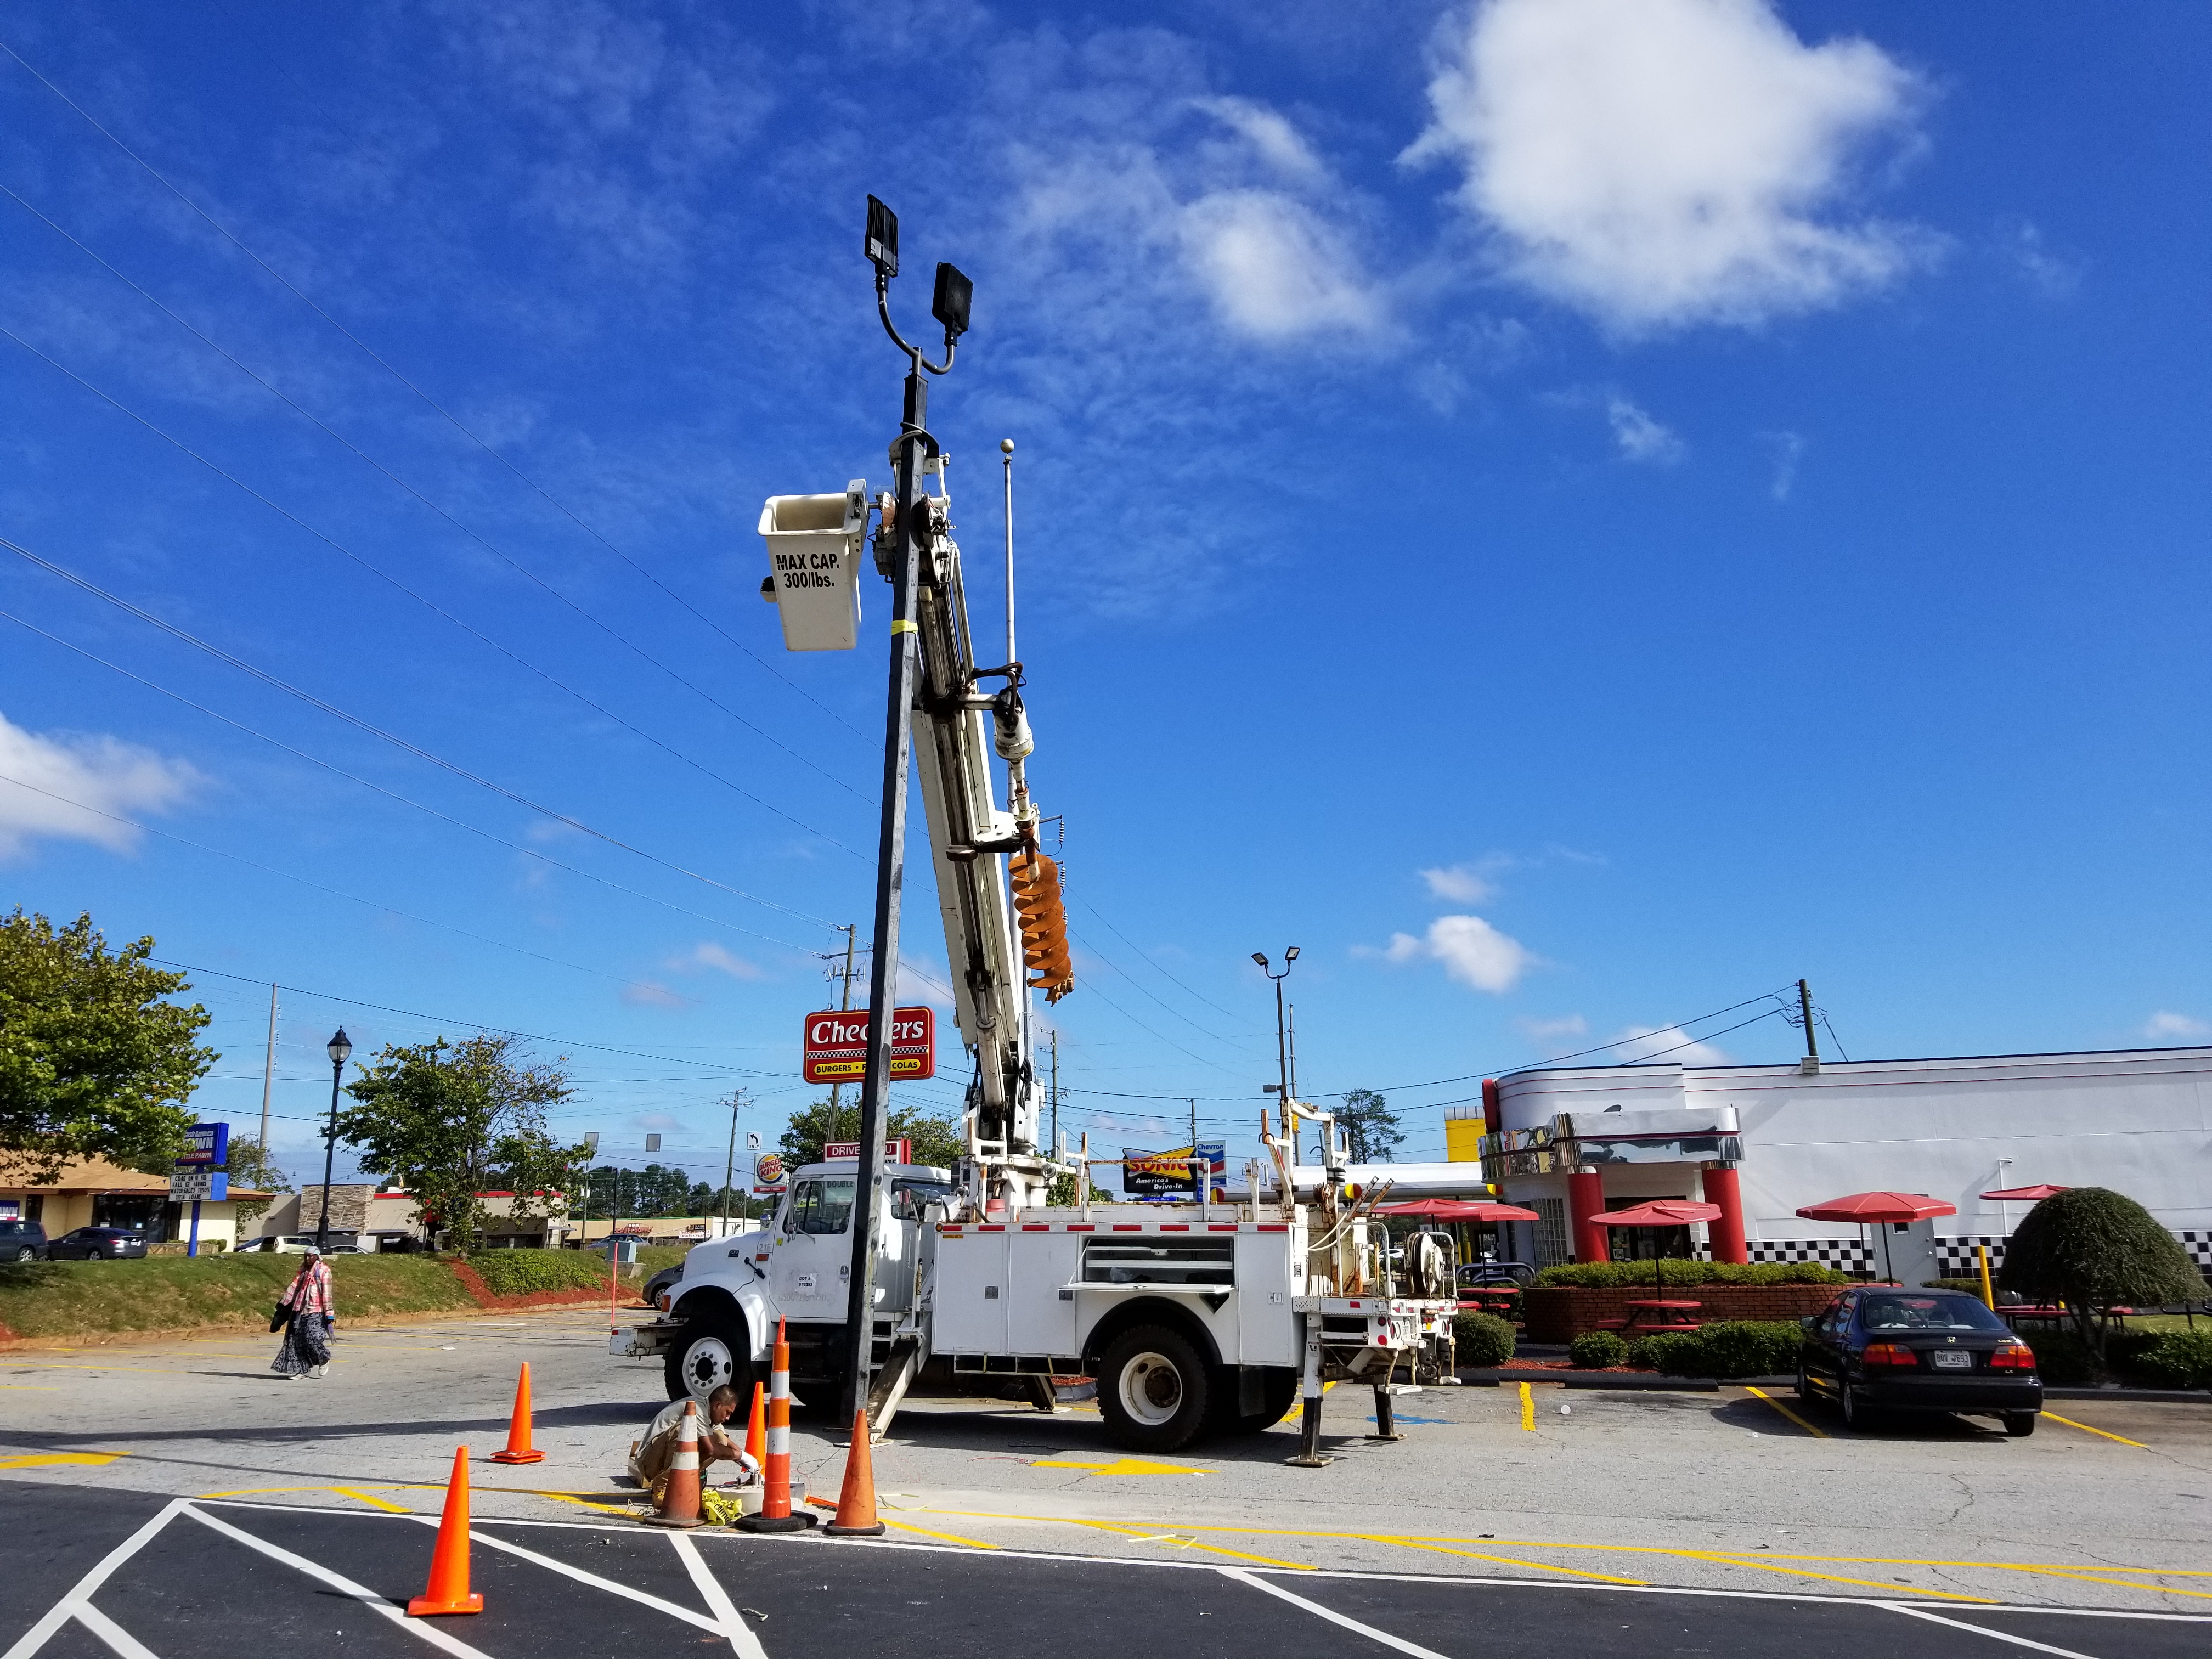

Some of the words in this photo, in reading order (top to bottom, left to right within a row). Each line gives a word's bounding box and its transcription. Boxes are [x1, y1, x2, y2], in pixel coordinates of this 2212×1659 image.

[776, 554, 808, 571] MAX
[810, 553, 840, 569] CAP.
[783, 571, 836, 589] 300/lbs.
[811, 1020, 924, 1043] Checers
[816, 1064, 852, 1073] BURGERS
[832, 1146, 860, 1155] DRIVE
[759, 1159, 781, 1171] BURGER
[760, 1164, 782, 1177] KING
[1130, 1156, 1189, 1172] SONIC
[759, 1243, 771, 1252] 216
[713, 1503, 730, 1522] CAUTIO
